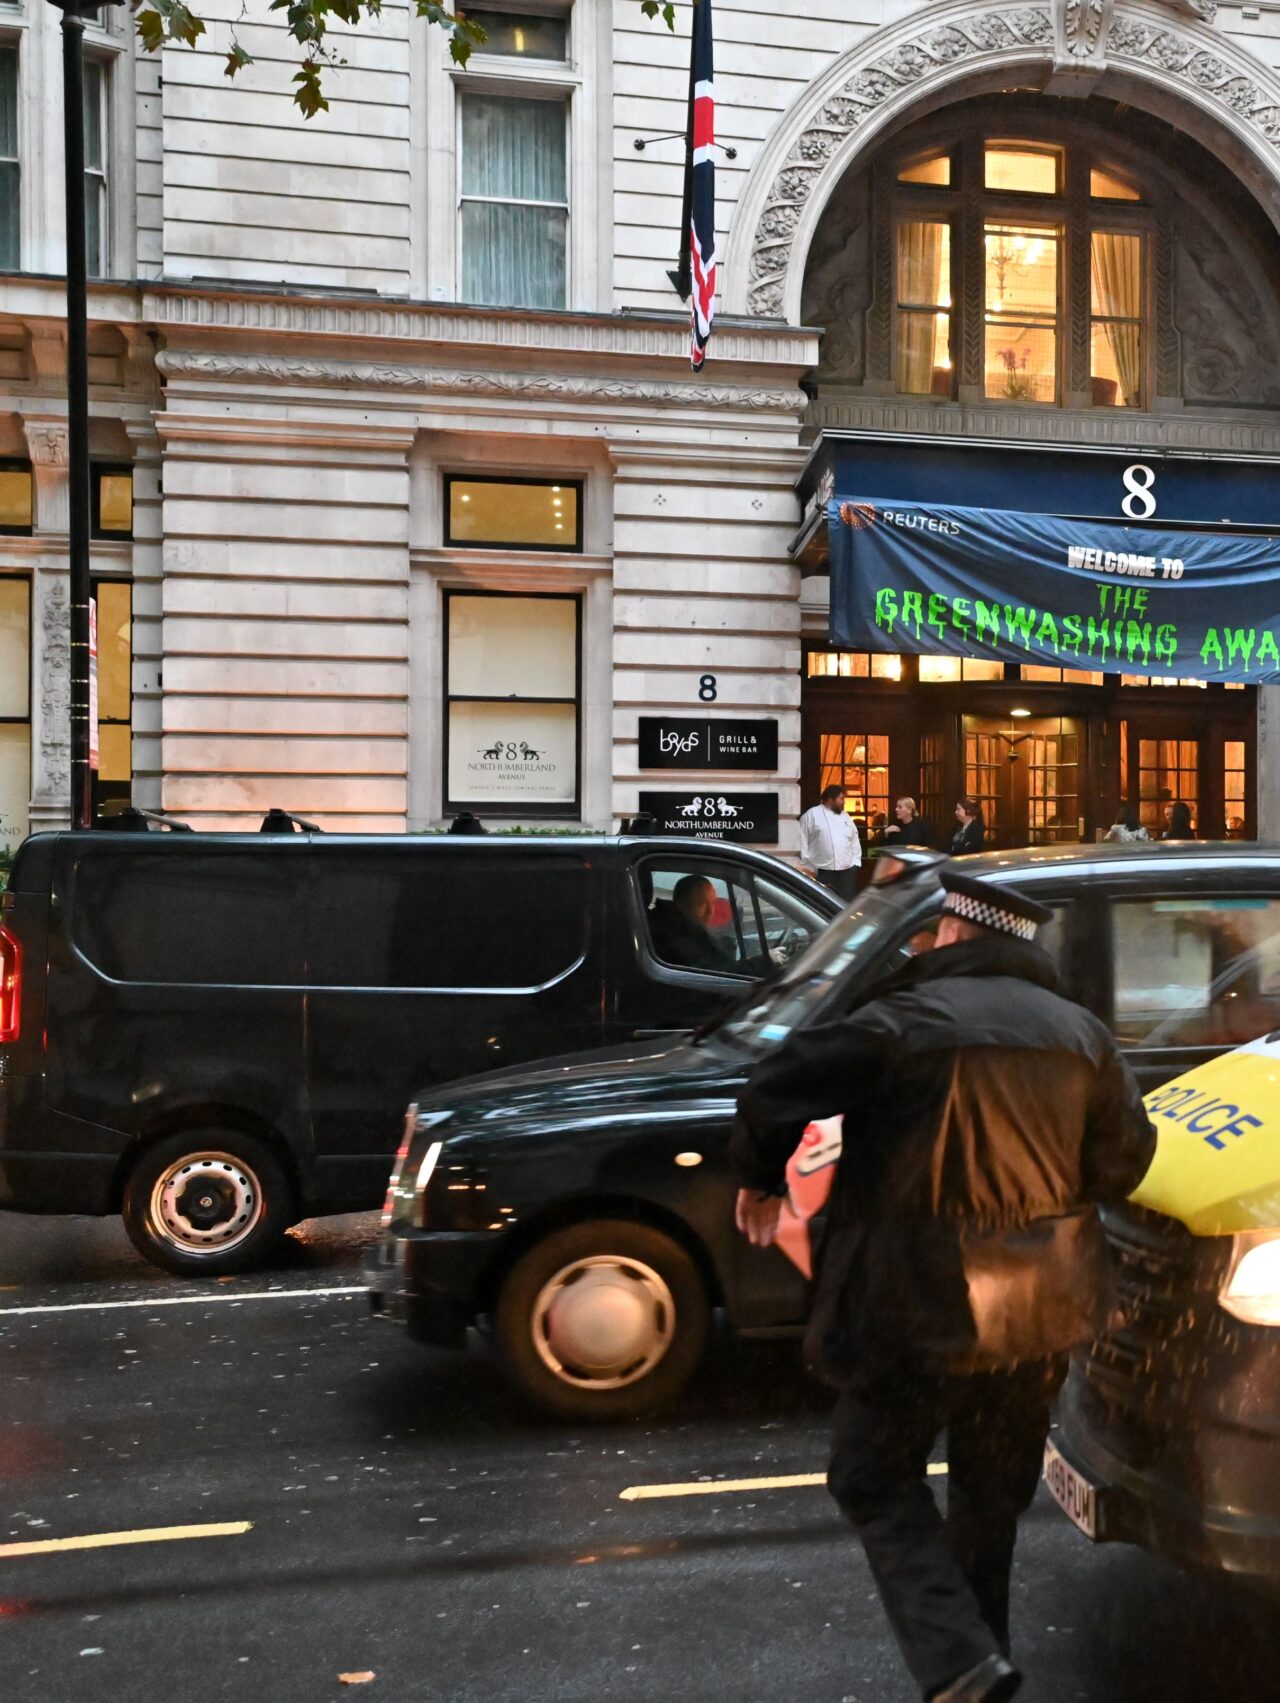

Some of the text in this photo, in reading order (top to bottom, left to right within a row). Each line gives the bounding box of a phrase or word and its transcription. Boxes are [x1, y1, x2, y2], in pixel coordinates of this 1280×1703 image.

[1121, 464, 1157, 519] 8
[882, 510, 961, 536] REUTERS
[1067, 545, 1185, 581] WELCOME TO
[1095, 583, 1150, 619] THE
[874, 587, 1179, 668] GREENWASHING
[698, 674, 718, 702] 8
[505, 742, 518, 761] 8
[659, 728, 700, 757] boyds
[467, 762, 556, 772] NORTHUMBERLAND
[703, 797, 716, 816] 8
[664, 820, 754, 830] NORTHUMBERLAND
[1146, 1086, 1265, 1151] POLICE
